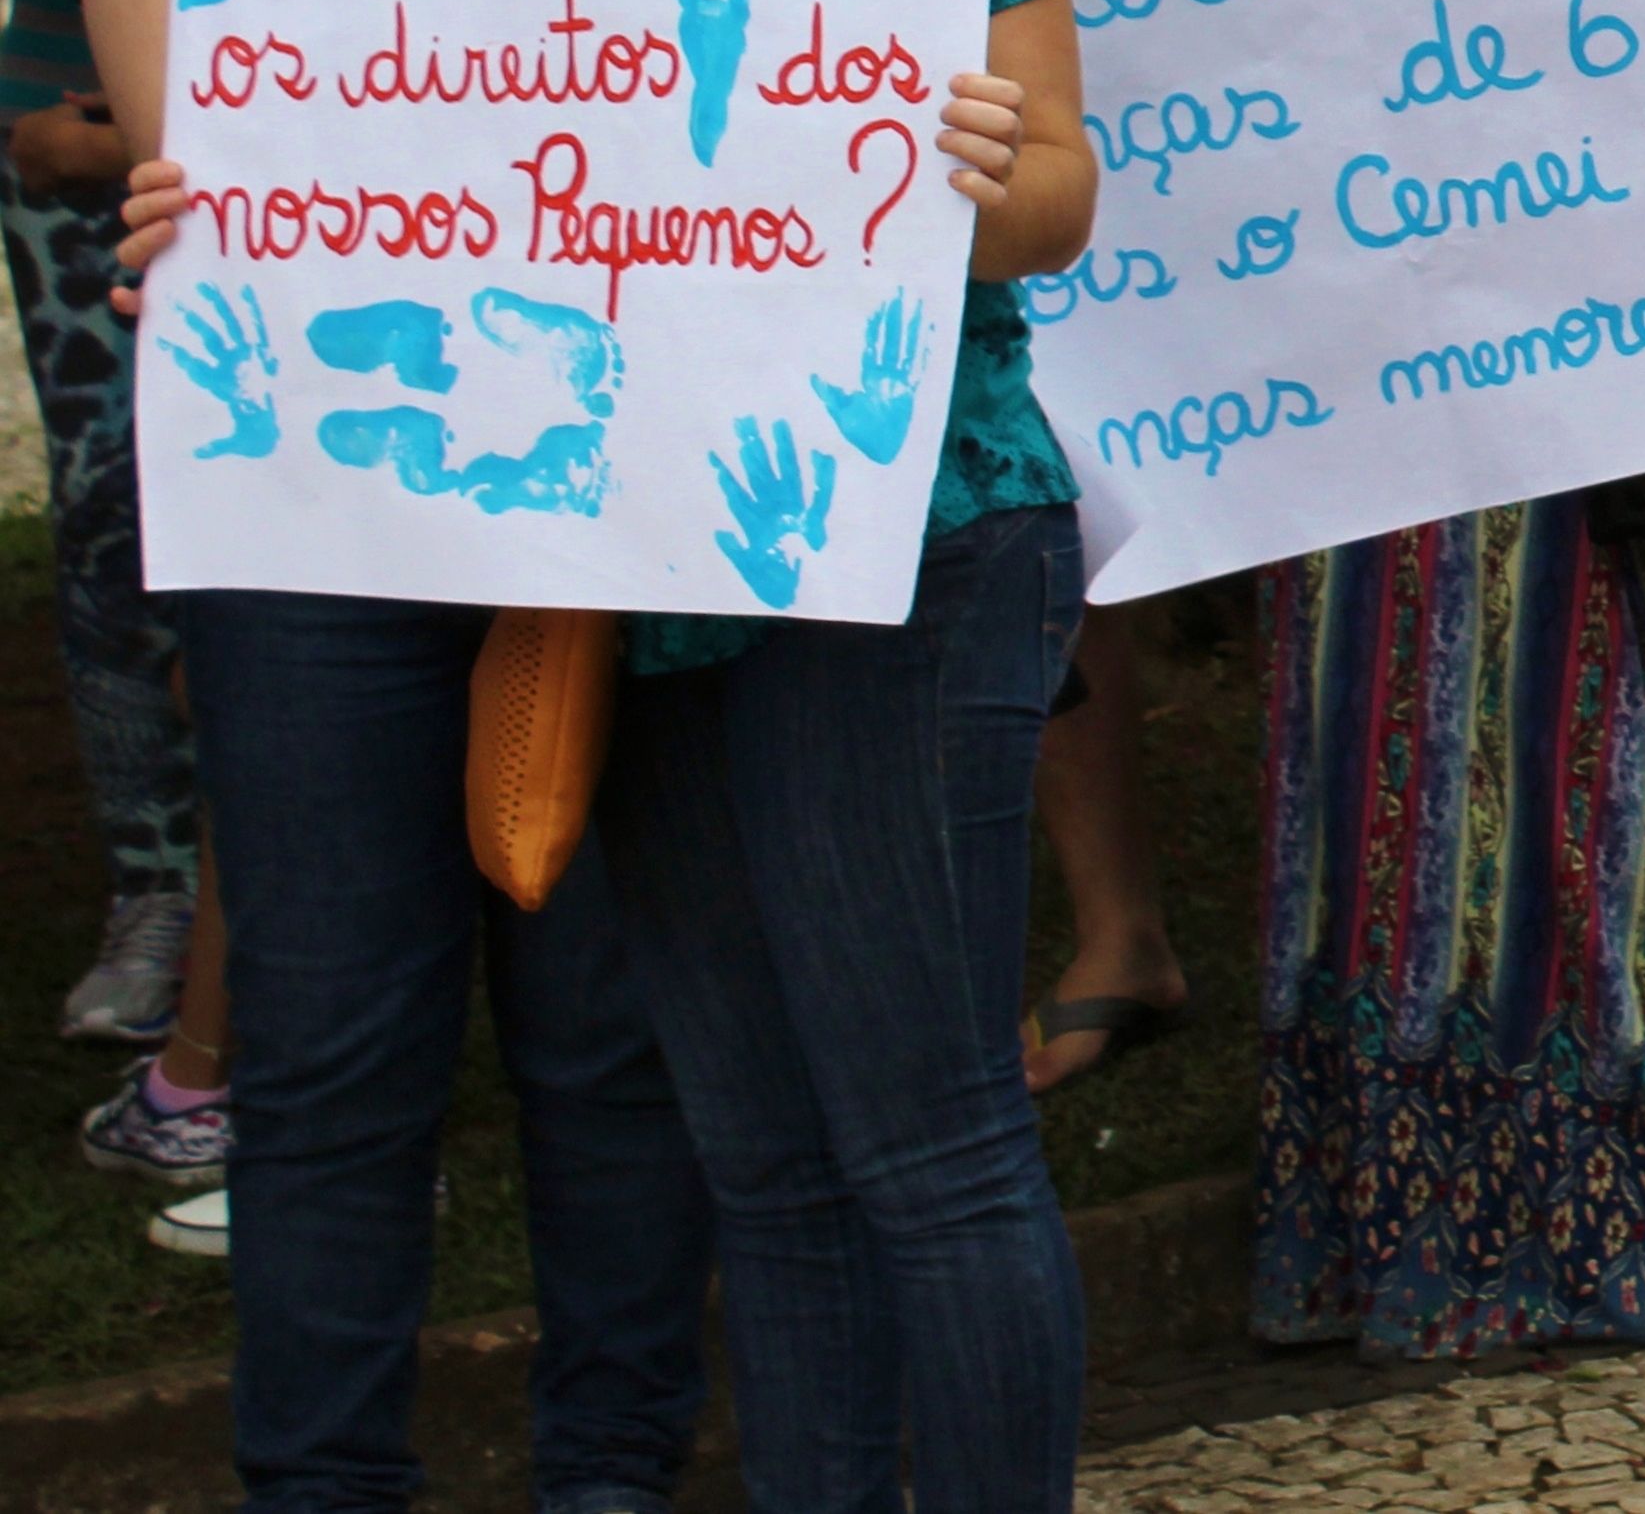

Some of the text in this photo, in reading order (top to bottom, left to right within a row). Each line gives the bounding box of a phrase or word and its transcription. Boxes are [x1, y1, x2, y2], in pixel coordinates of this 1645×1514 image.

[191, 31, 318, 109] os
[756, 1, 931, 107] dos
[1081, 88, 1300, 195] nças
[185, 186, 498, 262] nossos
[1024, 248, 1178, 325] ois
[1217, 209, 1300, 280] o
[1336, 137, 1630, 249] Cemei
[1098, 379, 1334, 477] nças
